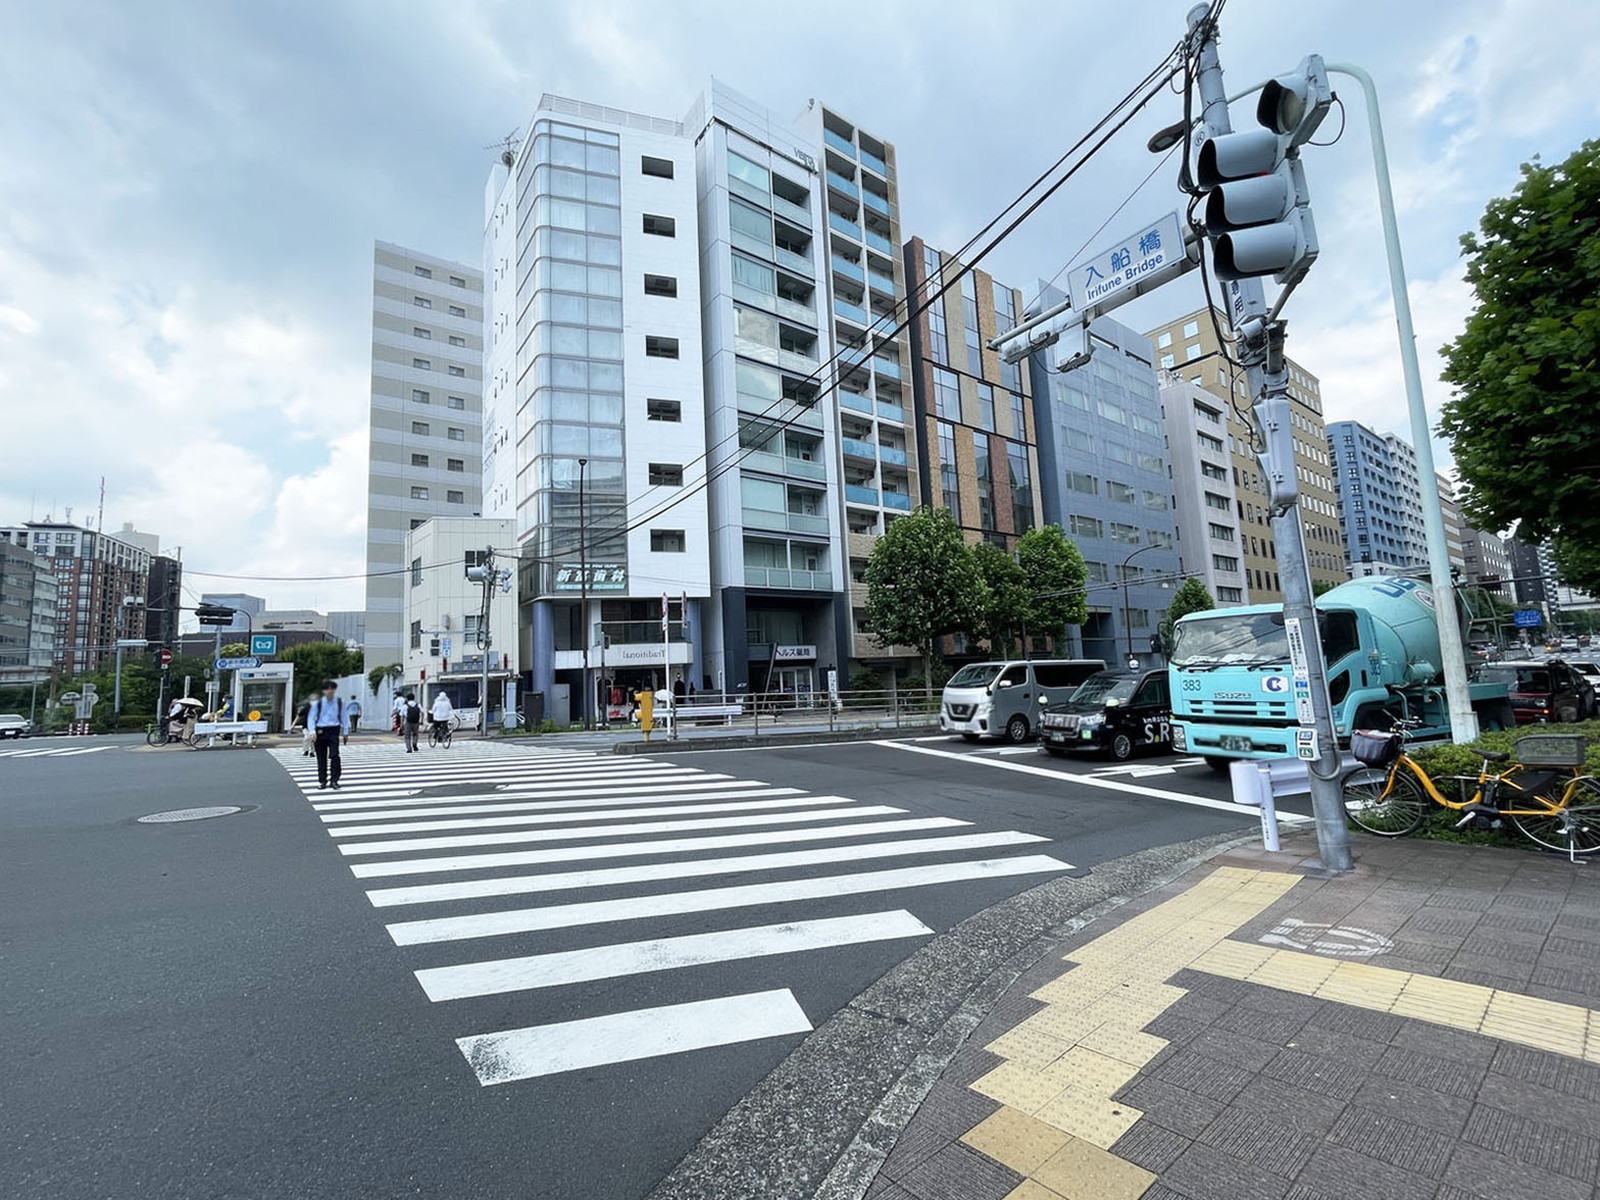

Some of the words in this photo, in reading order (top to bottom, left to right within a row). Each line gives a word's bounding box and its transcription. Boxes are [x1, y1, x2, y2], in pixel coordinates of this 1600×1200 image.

[1085, 229, 1161, 288] 入船橋
[1088, 276, 1122, 300] Irifune
[1125, 254, 1163, 280] Bridge
[1182, 680, 1201, 691] 383
